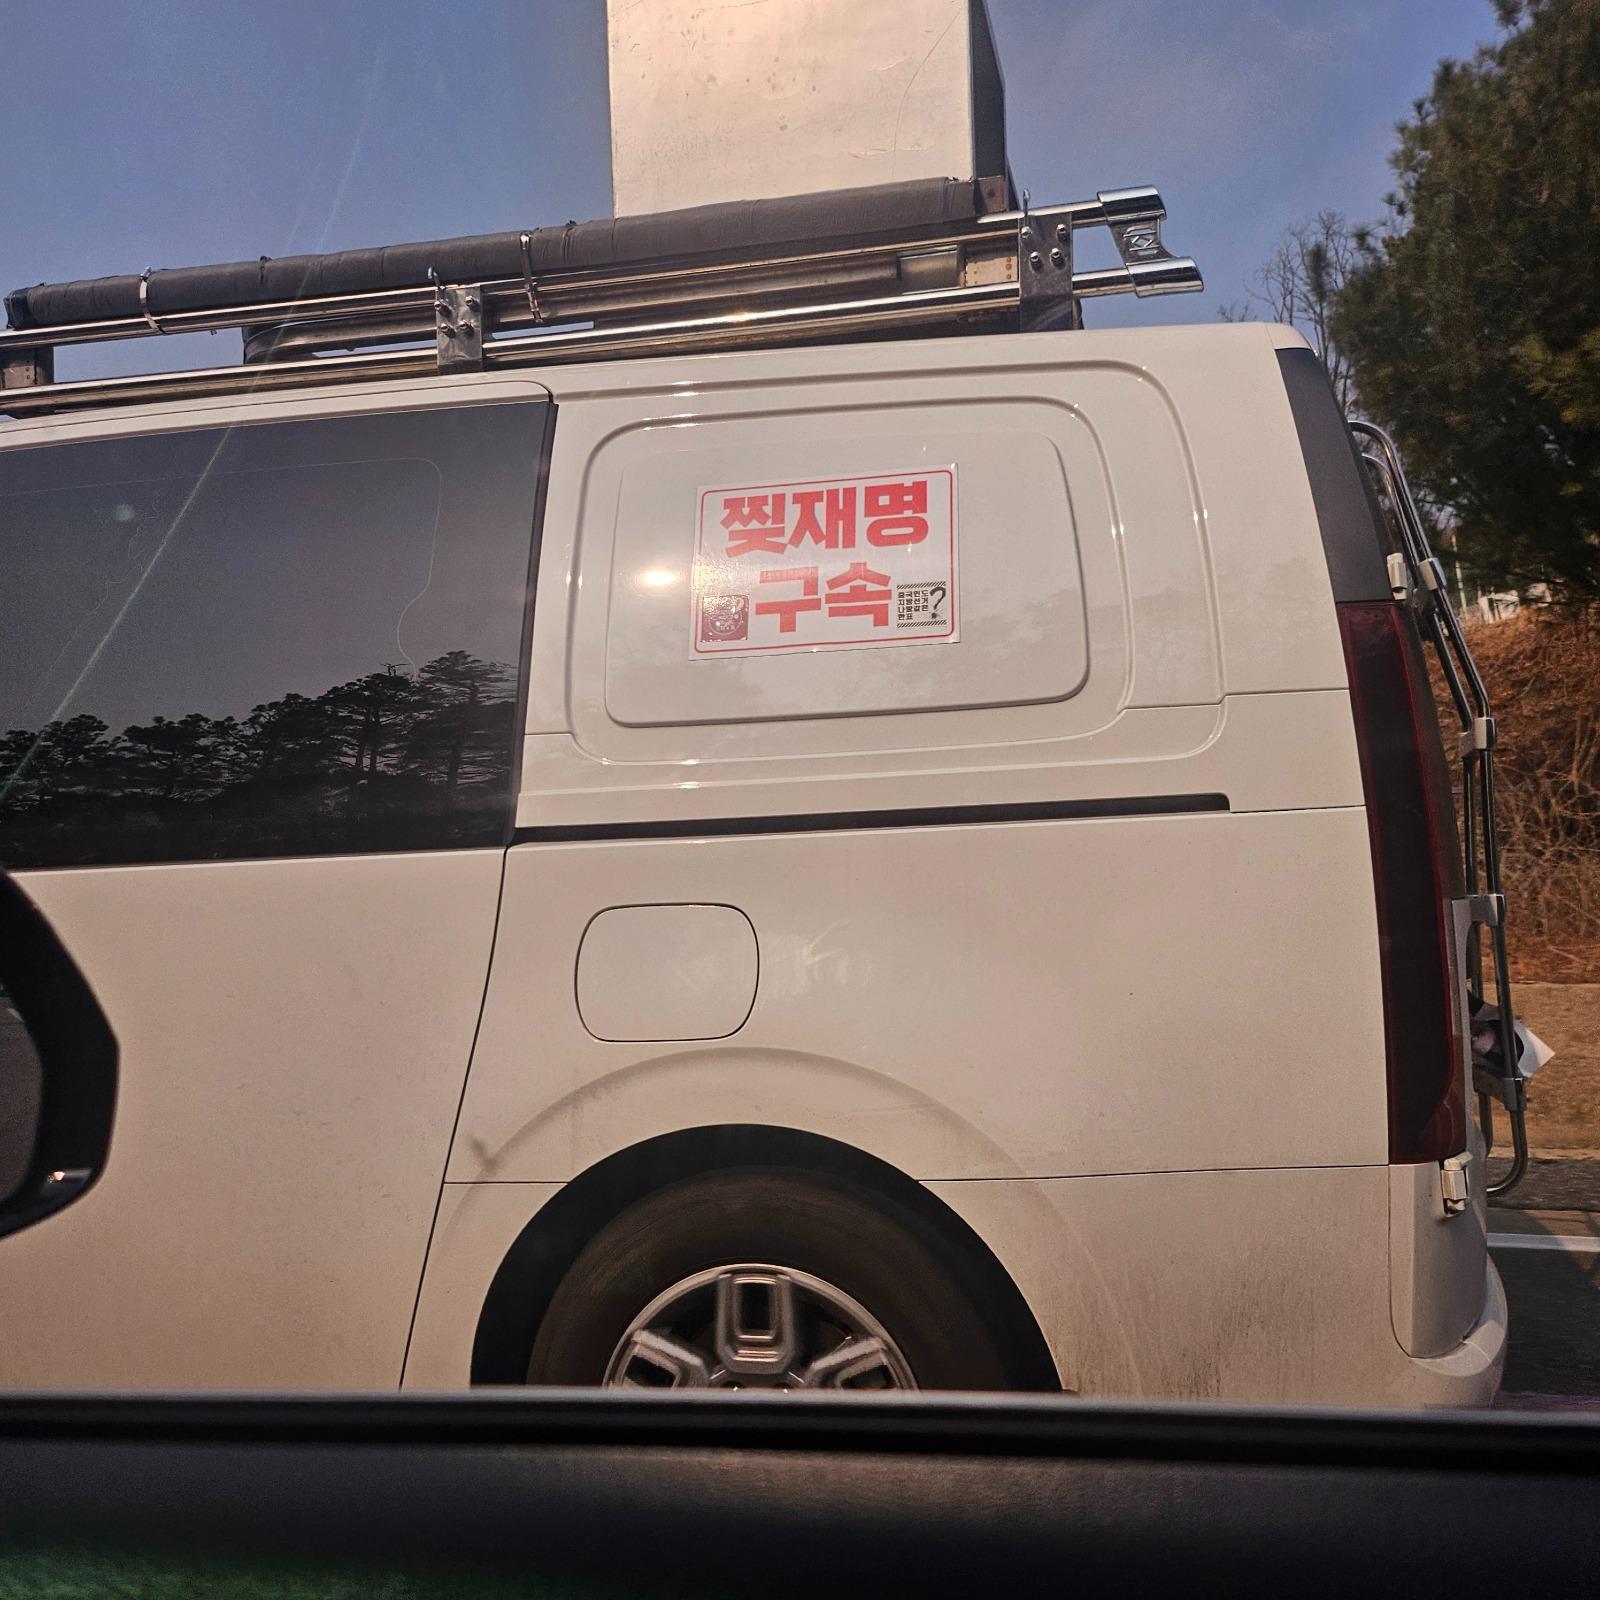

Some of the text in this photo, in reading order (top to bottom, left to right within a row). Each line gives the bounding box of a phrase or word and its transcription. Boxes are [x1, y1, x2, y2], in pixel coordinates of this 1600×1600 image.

[720, 480, 929, 557] 찢재명
[755, 562, 893, 633] 구속
[897, 597, 929, 606] 지방선거
[898, 613, 913, 621] 한표
